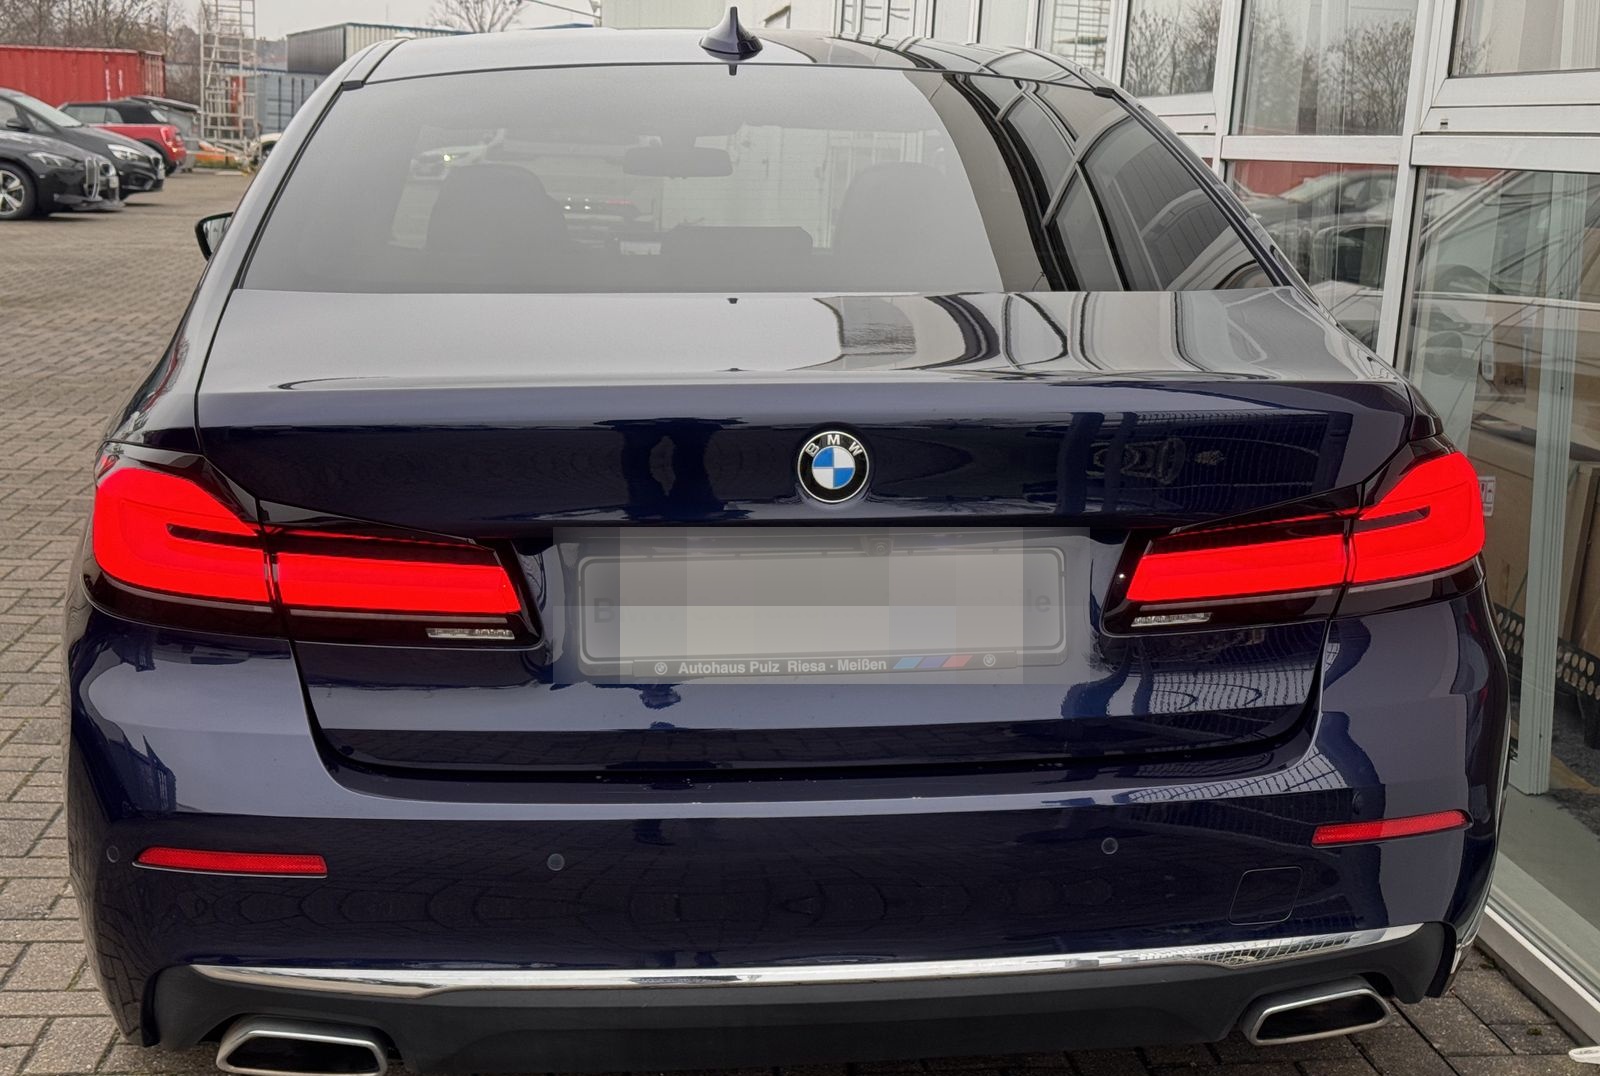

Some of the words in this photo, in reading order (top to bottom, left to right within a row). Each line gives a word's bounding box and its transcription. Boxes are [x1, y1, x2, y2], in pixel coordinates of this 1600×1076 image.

[805, 434, 863, 457] BMW
[678, 661, 746, 674] Autohaus
[750, 661, 780, 673] Pulz
[787, 660, 826, 672] Riesa
[837, 658, 887, 671] Meißen
